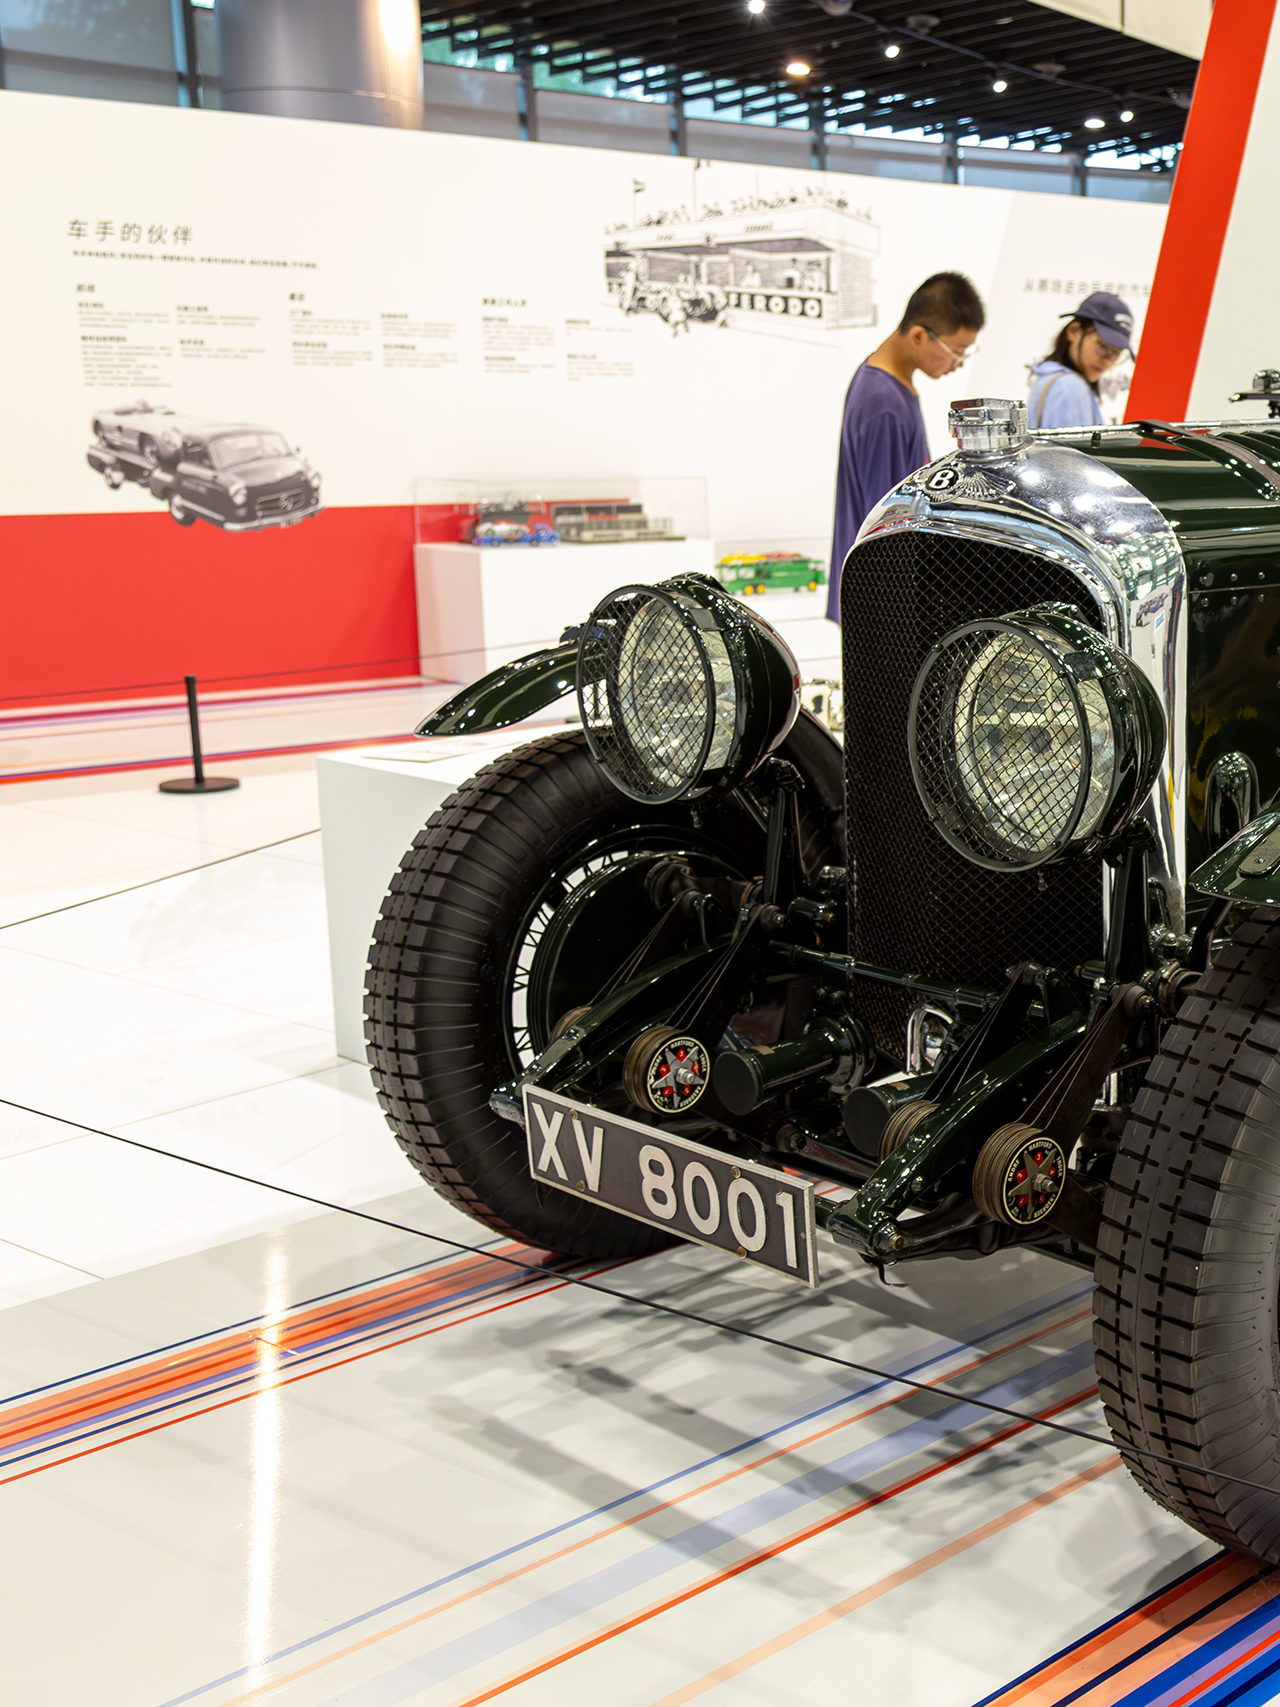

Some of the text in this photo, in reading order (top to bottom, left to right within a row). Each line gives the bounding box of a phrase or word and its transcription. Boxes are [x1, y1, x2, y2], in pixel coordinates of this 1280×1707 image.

[67, 219, 194, 246] 车手的伙伴
[729, 292, 821, 318] FERODO
[929, 469, 955, 489] B
[531, 1102, 798, 1269] XV 8001
